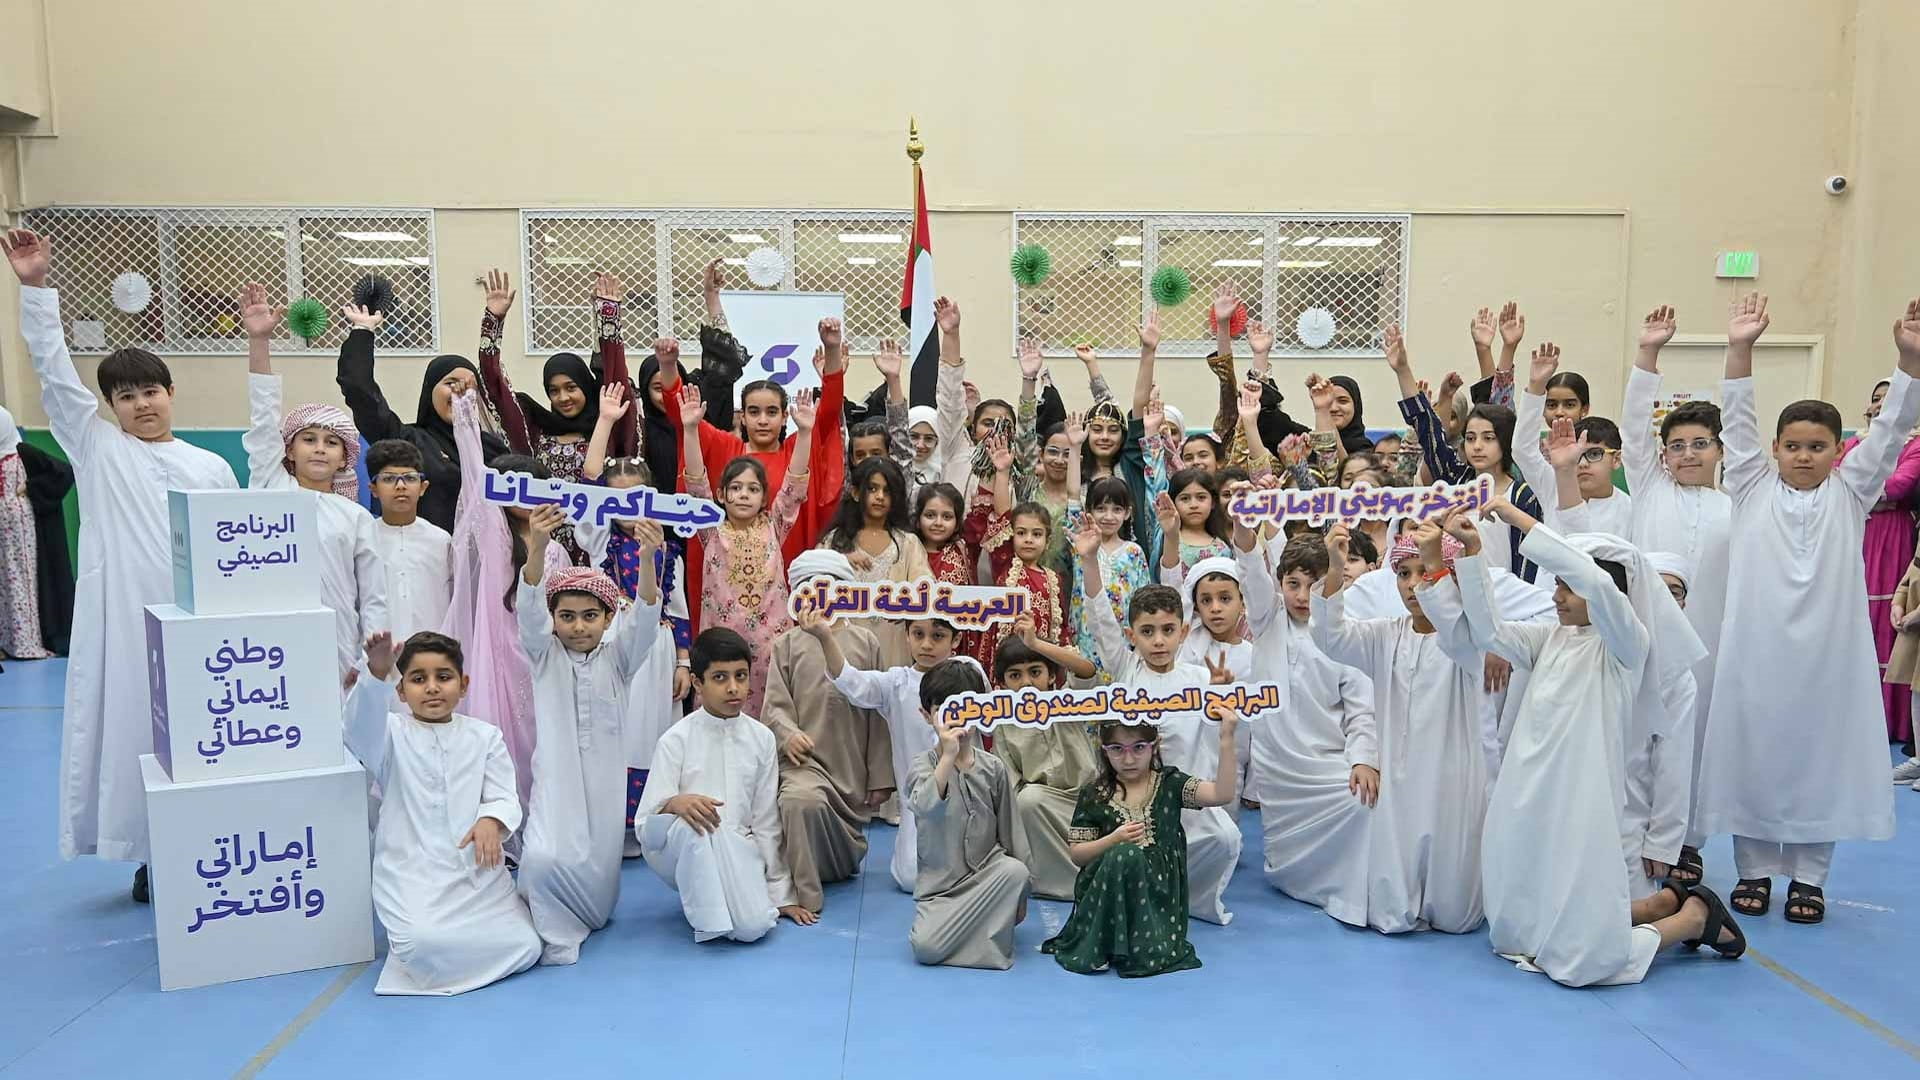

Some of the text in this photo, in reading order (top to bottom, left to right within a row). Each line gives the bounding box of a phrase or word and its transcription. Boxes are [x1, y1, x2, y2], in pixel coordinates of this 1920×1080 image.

[1232, 491, 1335, 522] الإماراتية
[1340, 487, 1414, 523] بهويتي
[216, 513, 295, 542] البرنامج
[217, 544, 298, 577] الصيفي
[934, 587, 1024, 623] العربية
[205, 637, 285, 681] وطني
[207, 676, 290, 721] إيماني
[943, 685, 1280, 728] البرامج الصيفية لصندوق الوطن
[197, 719, 302, 764] وعطائي
[196, 826, 318, 888] إماراتي
[187, 870, 325, 933] وأفتخر
